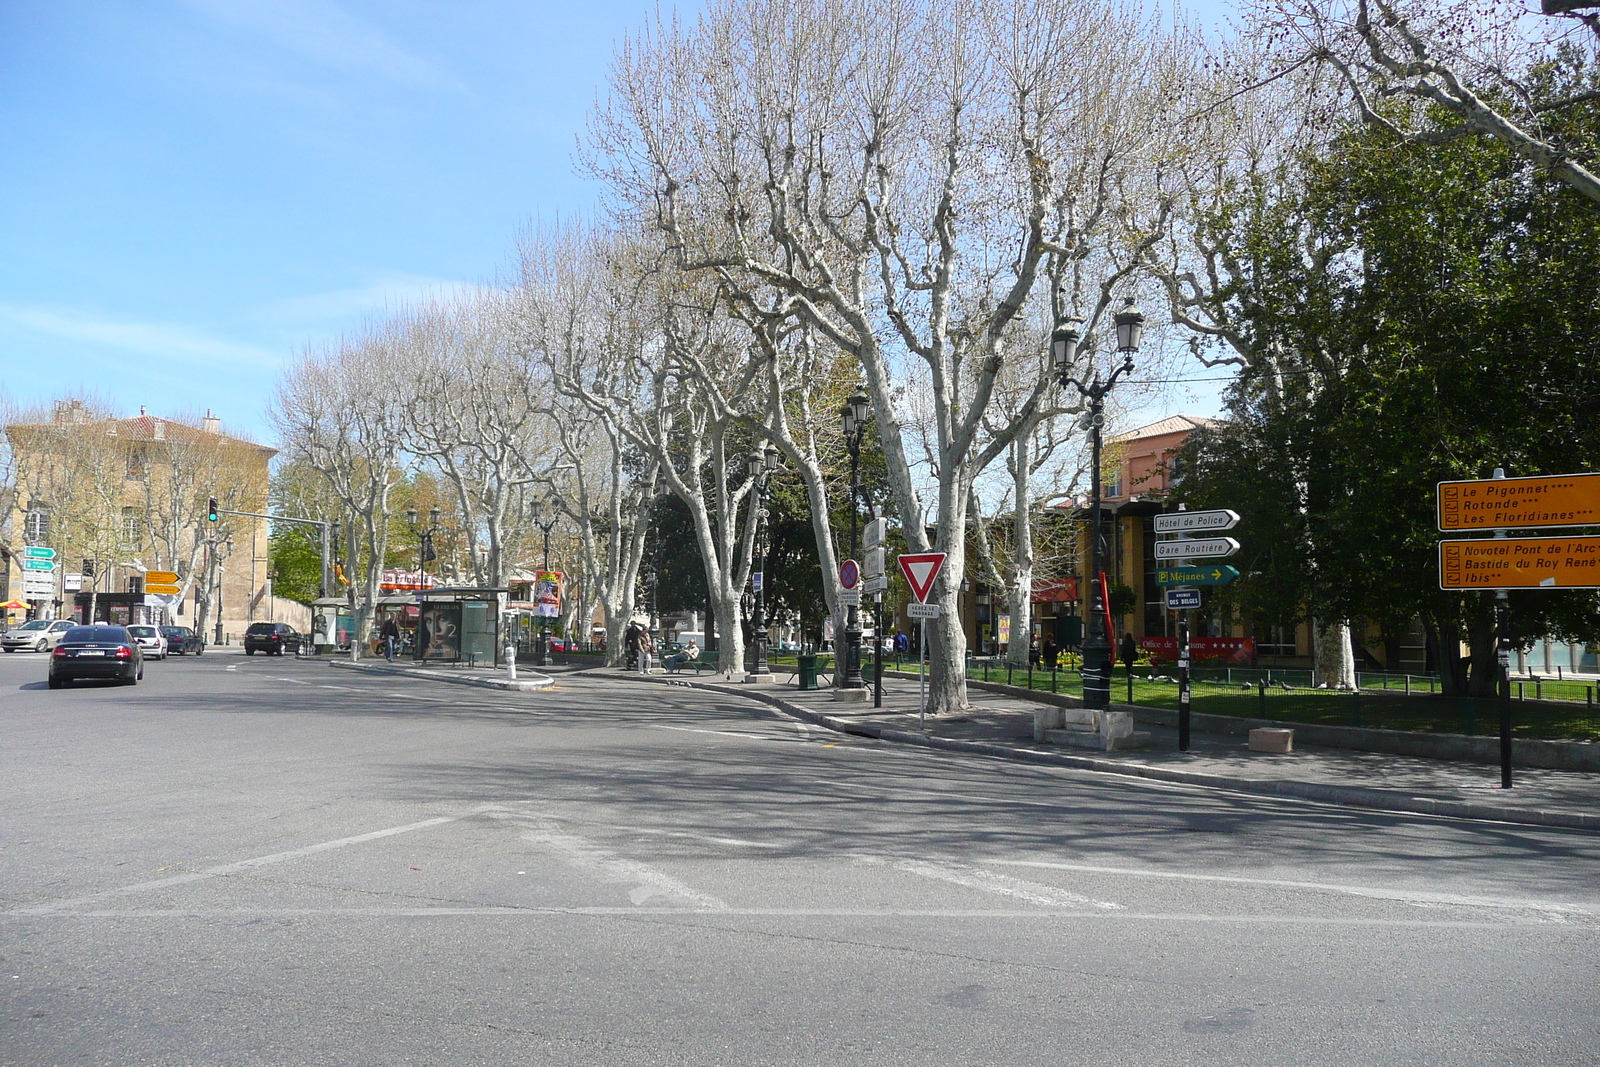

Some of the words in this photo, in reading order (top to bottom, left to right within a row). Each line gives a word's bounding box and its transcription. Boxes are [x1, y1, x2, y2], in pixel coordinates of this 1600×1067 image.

[1462, 487, 1477, 497] Le
[1486, 484, 1548, 498] Pigonnet
[1463, 499, 1519, 510] Rotonde
[1158, 518, 1180, 528] Hôtel
[1183, 517, 1194, 526] de
[1197, 516, 1223, 525] Police
[1463, 514, 1485, 524] Les
[1494, 511, 1575, 523] Floridianes
[1159, 546, 1179, 555] Gare
[1184, 543, 1223, 553] Routière
[1464, 545, 1510, 556] Novotel
[1513, 545, 1541, 555] Pont
[1547, 544, 1562, 554] de
[1465, 559, 1510, 569] Bastide
[1516, 558, 1530, 568] du
[1536, 558, 1559, 570] Roy
[1565, 556, 1596, 568] René
[1170, 572, 1205, 582] Méjanes
[1465, 573, 1490, 583] Ibis
[1142, 640, 1161, 648] Office
[1164, 640, 1173, 648] de
[1175, 641, 1206, 649] Trisme
